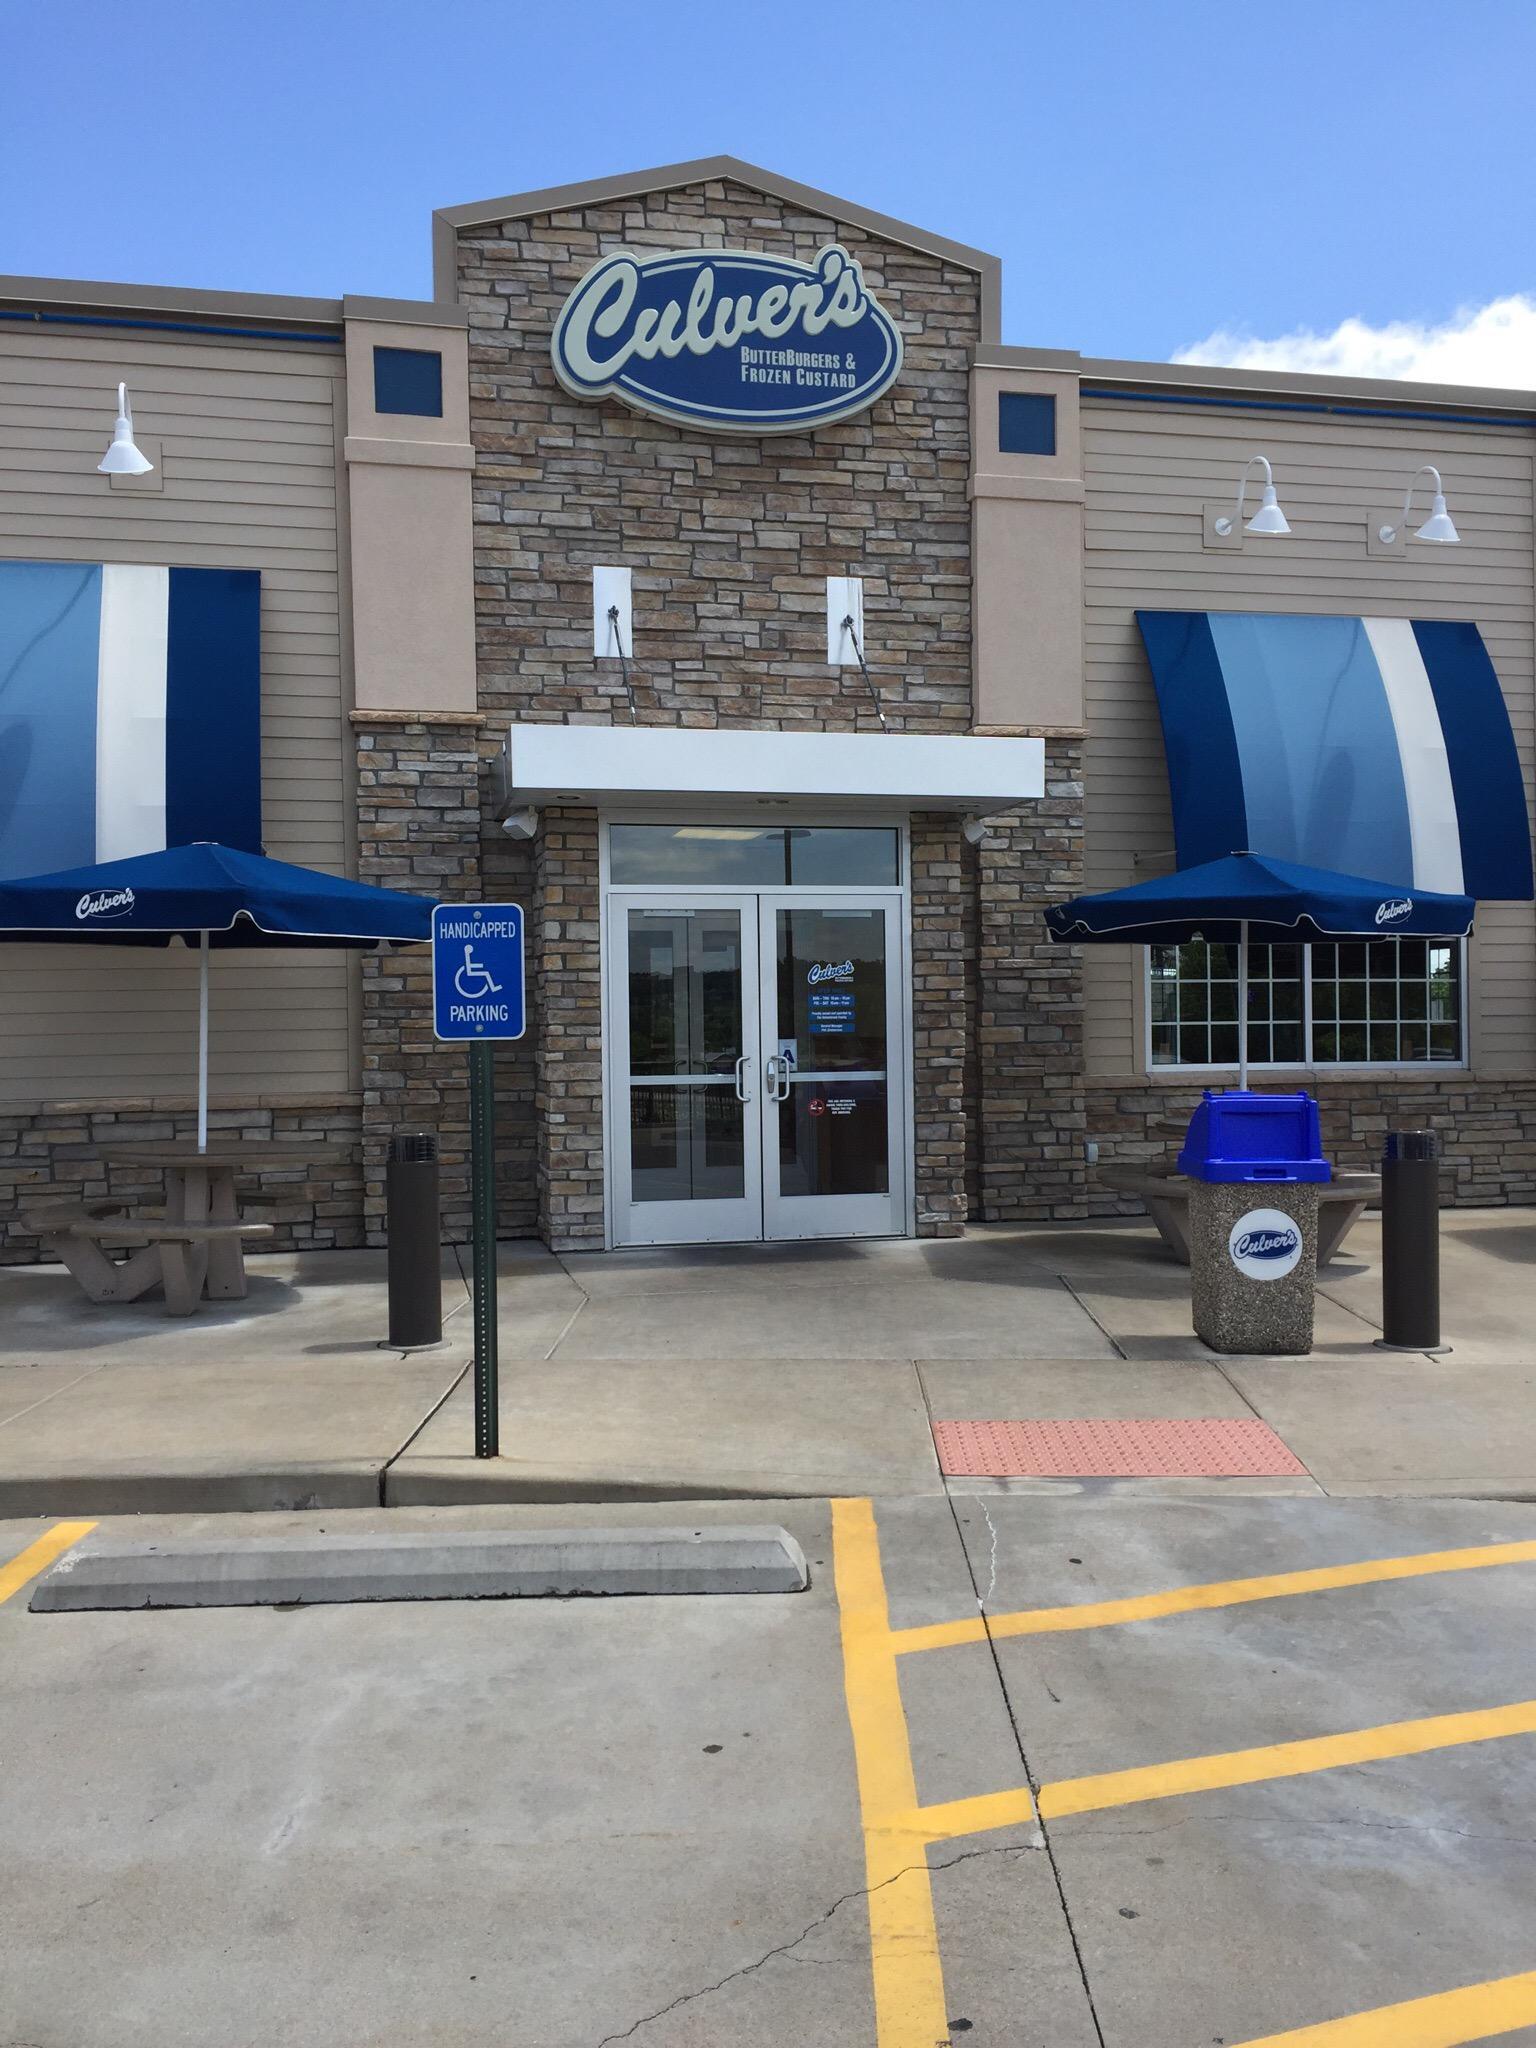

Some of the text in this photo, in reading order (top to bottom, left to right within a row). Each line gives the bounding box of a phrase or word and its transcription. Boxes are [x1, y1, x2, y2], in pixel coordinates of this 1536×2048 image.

[564, 253, 867, 382] Culver's
[845, 353, 856, 370] &
[75, 887, 136, 919] Culver's
[1374, 897, 1413, 925] Culver's
[440, 921, 516, 939] HANDICAPPED
[808, 960, 854, 984] Culver's
[450, 1004, 509, 1022] PARKING
[1234, 1229, 1297, 1259] Culver's
